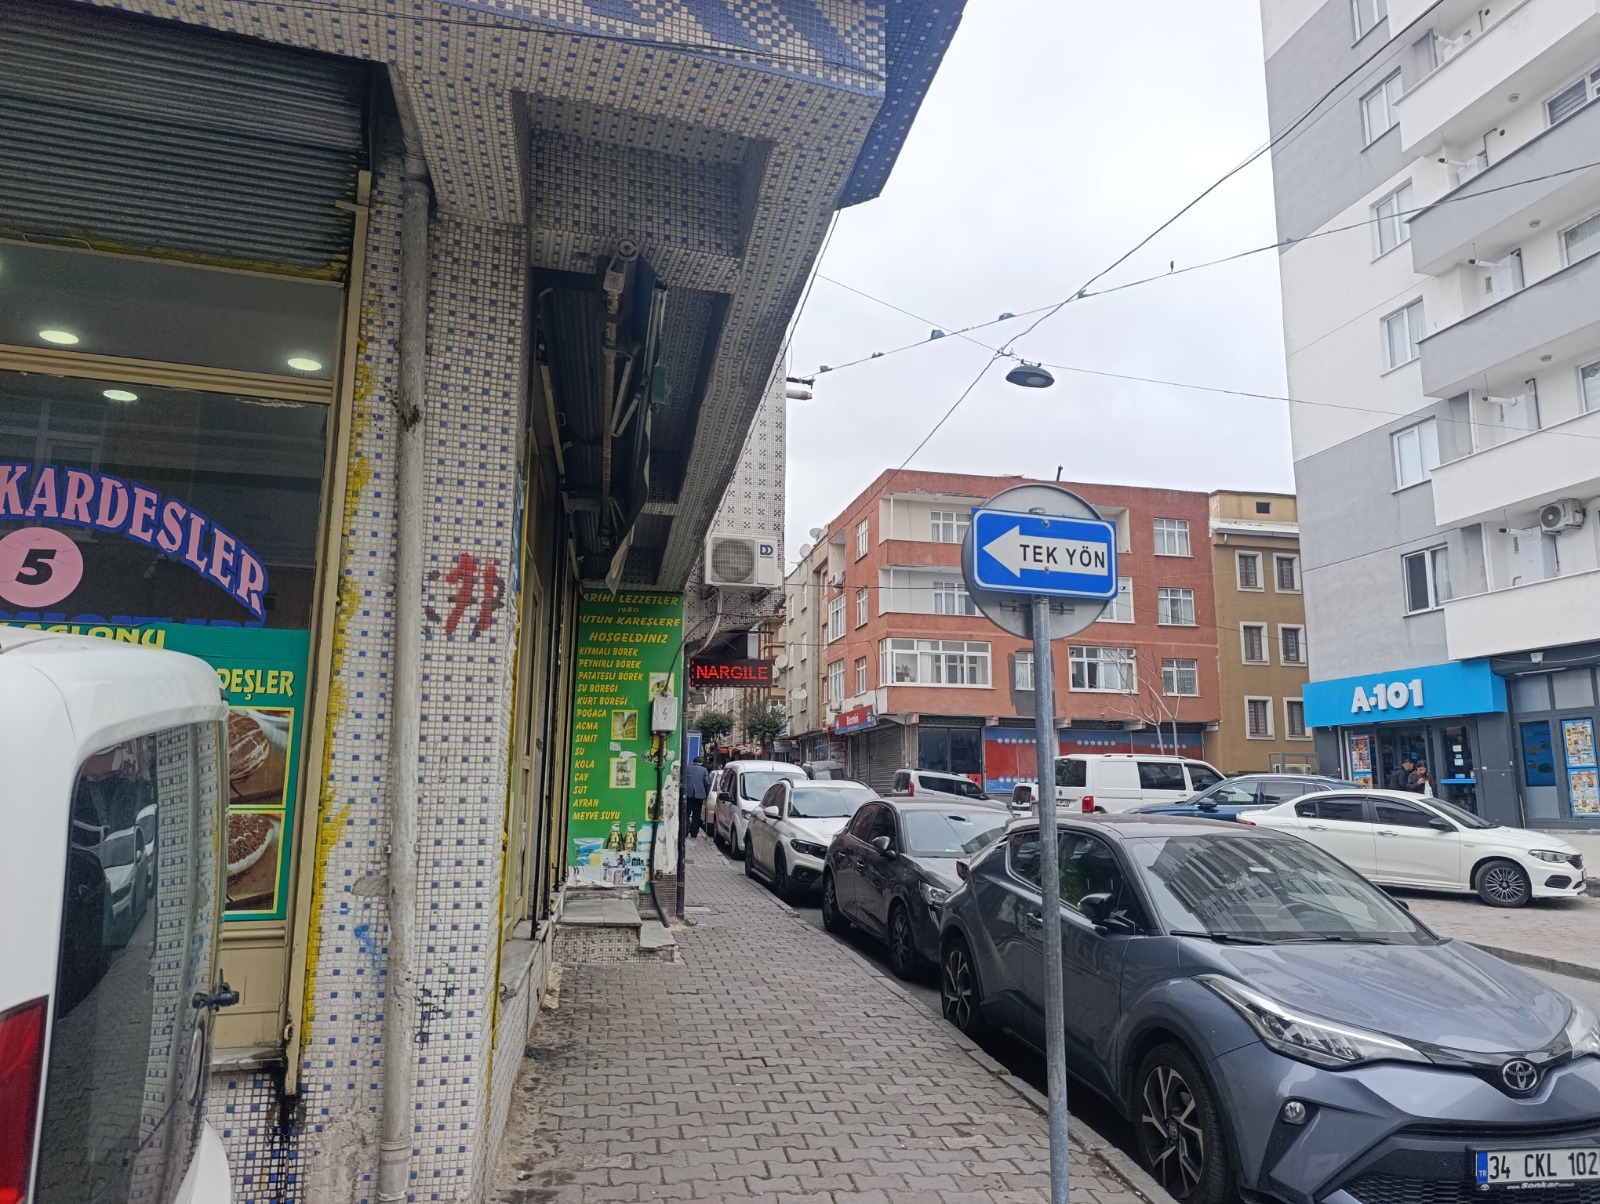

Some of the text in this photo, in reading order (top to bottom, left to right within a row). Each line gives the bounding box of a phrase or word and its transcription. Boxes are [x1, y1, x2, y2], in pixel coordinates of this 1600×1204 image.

[1019, 543, 1105, 568] TEK YÖN
[15, 548, 57, 586] 5
[618, 594, 679, 605] LEZZETLER
[616, 616, 682, 627] KAREŞLERE
[588, 631, 669, 644] HOŞGELDİNİZ
[578, 646, 638, 657] KIYMALI BÖREK
[615, 658, 642, 669] BÖREK
[577, 670, 644, 681] PATATESLİ BÖREK
[216, 667, 295, 701] DEŞLER
[577, 683, 588, 692] SU
[574, 746, 586, 756] SU
[574, 759, 595, 769] KOLA
[573, 772, 589, 783] ÇAY
[572, 783, 589, 795] SÜT
[572, 798, 600, 808] AYRAN
[572, 811, 621, 821] MEYVE SUYU
[1489, 1151, 1598, 1180] 34 CKL 102
[1478, 1170, 1488, 1178] TR
